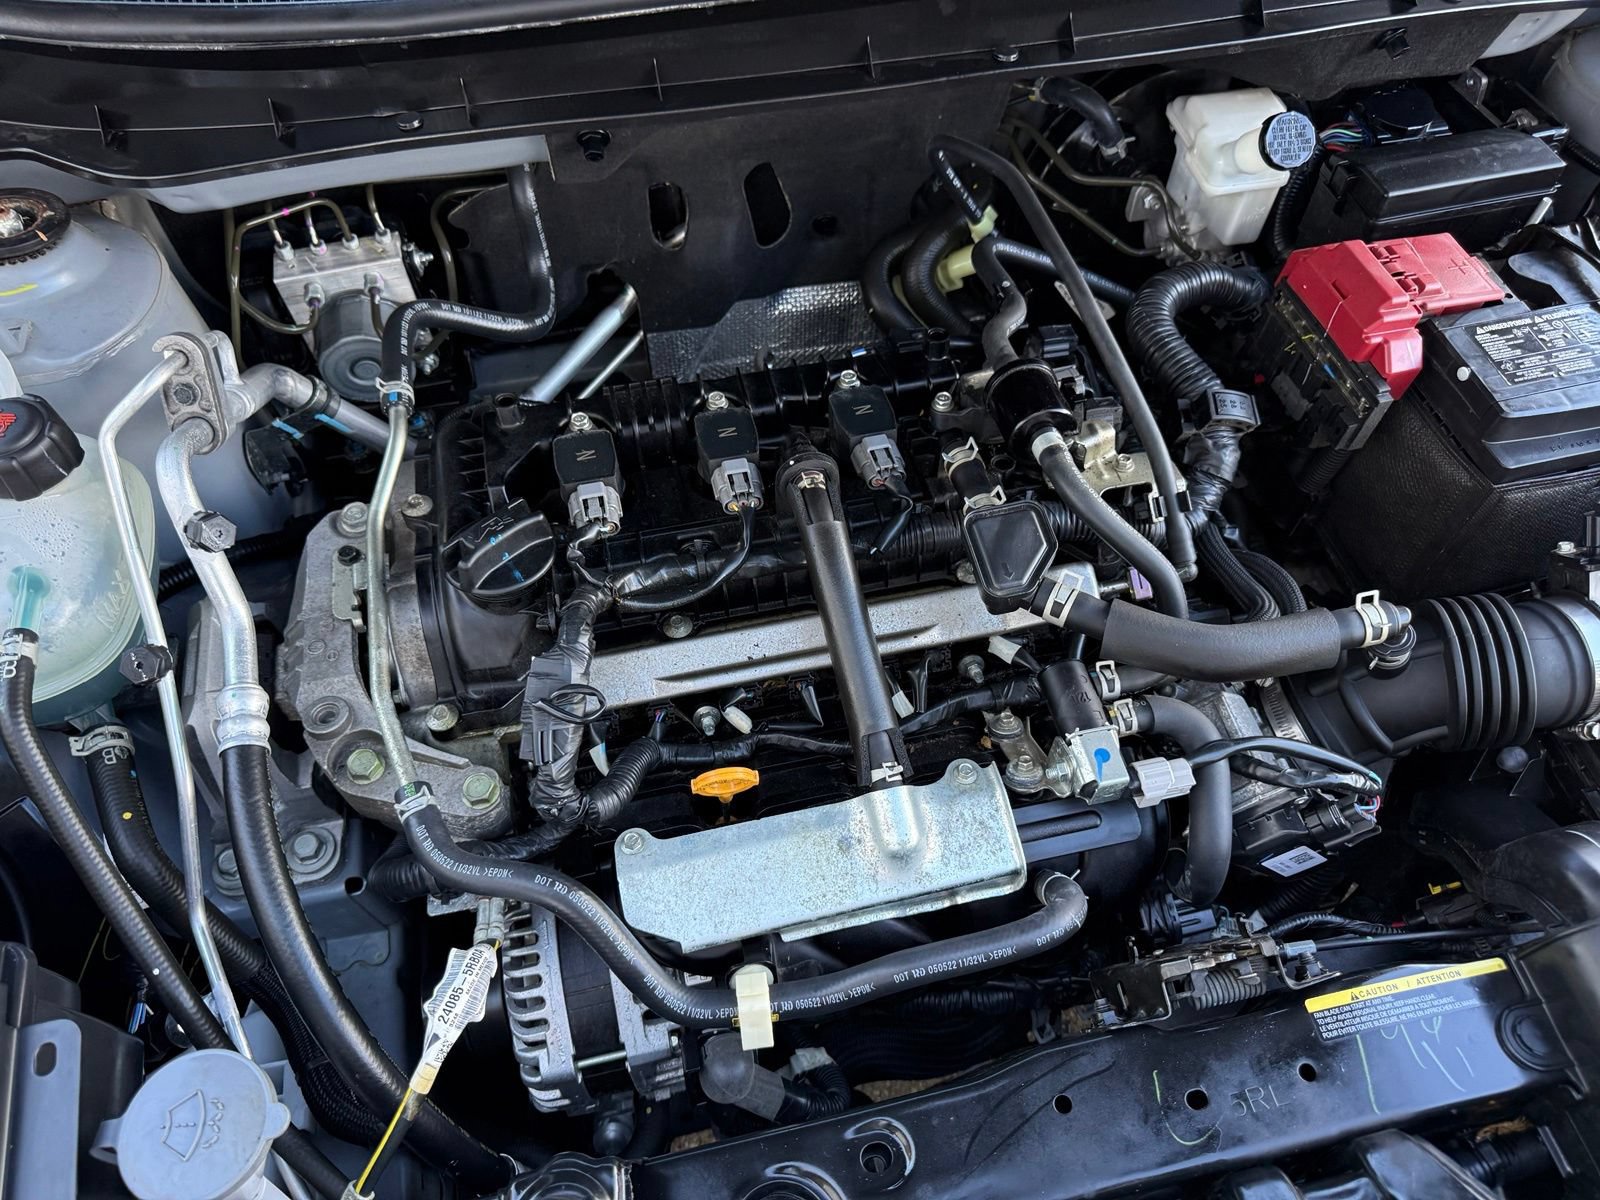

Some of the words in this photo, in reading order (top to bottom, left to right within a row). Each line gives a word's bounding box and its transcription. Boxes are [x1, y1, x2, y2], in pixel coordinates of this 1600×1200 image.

[416, 824, 429, 840] DOT
[430, 848, 454, 869] 050522
[534, 874, 552, 886] DOT
[569, 891, 596, 917] 050522
[1036, 934, 1050, 946] DOT
[894, 972, 909, 983] DOT
[928, 960, 957, 974] 050522
[1358, 984, 1398, 998] CAUTION
[1416, 970, 1461, 986] ATTENTION
[644, 974, 657, 989] DOT
[664, 994, 687, 1014] 050522
[796, 998, 822, 1009] 050522
[1324, 1008, 1340, 1017] BLADE
[1340, 1005, 1351, 1014] CAN
[1324, 1015, 1337, 1023] HELP
[1338, 1012, 1352, 1021] AVOID
[1353, 1007, 1378, 1018] PERSONAL
[1327, 1018, 1361, 1030] VENTILATEUR
[1322, 1030, 1338, 1039] POUR
[1357, 1021, 1373, 1031] TOUTE
